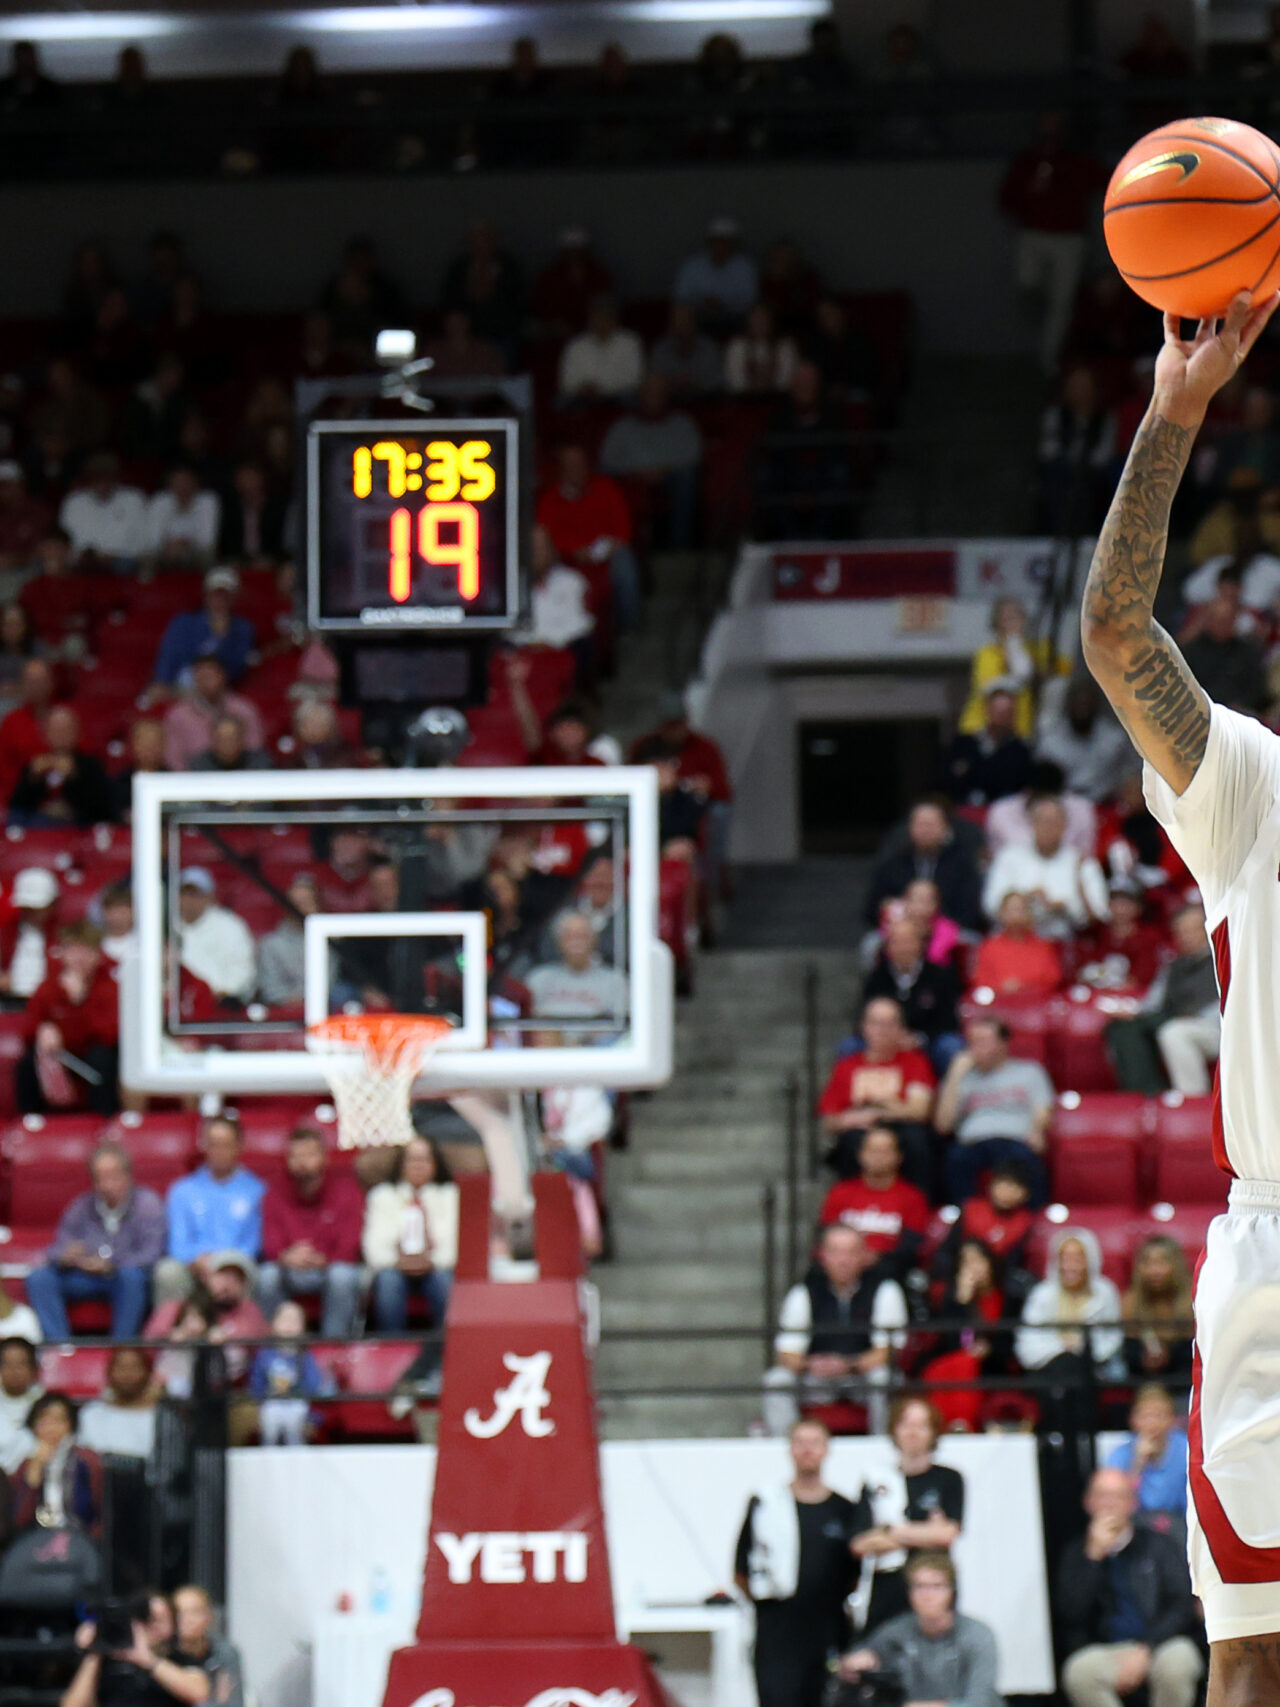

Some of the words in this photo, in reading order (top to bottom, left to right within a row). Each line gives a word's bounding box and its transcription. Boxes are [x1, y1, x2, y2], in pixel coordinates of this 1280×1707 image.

[353, 440, 496, 501] 17:35
[389, 501, 480, 603] 19
[435, 1531, 588, 1584] YETI
